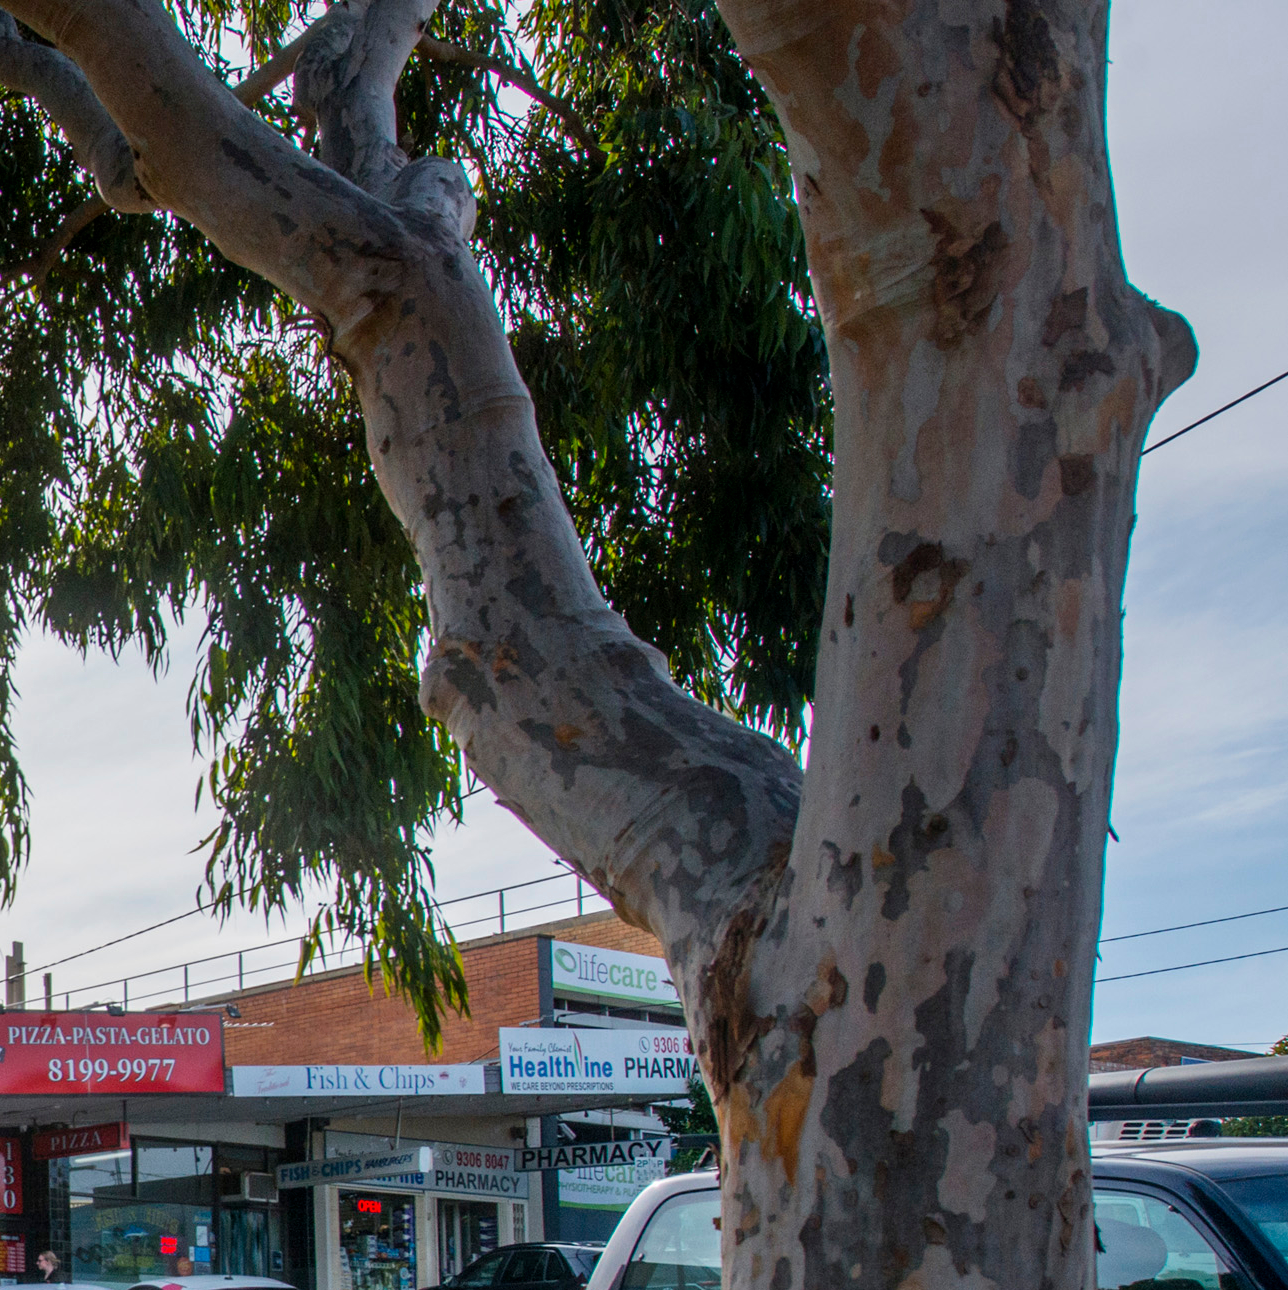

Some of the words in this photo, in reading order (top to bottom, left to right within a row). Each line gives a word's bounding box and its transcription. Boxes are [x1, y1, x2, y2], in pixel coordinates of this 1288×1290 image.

[577, 952, 657, 991] lifecare
[8, 1026, 210, 1045] PIZZA-PASTA-GELATO
[653, 1036, 679, 1054] 9306
[524, 1042, 547, 1056] Family
[548, 1043, 573, 1053] Chemist
[48, 1058, 176, 1083] 8199-9977
[624, 1057, 701, 1078] PHARMA
[306, 1066, 347, 1090] Fish
[354, 1067, 371, 1090] &
[378, 1066, 435, 1094] Chips
[511, 1082, 521, 1090] WE
[523, 1082, 539, 1091] CARE
[540, 1082, 565, 1091] BEYOND
[566, 1081, 614, 1092] PRESCRIPTIONS
[51, 1130, 103, 1151] PIZZA
[456, 1151, 482, 1168] 9306
[485, 1153, 510, 1170] 8047
[522, 1141, 663, 1169] PHARMACY
[281, 1165, 310, 1183] FISH
[322, 1158, 361, 1178] CHIPS
[435, 1170, 520, 1193] PHARMACY
[357, 1200, 382, 1214] OPEN
